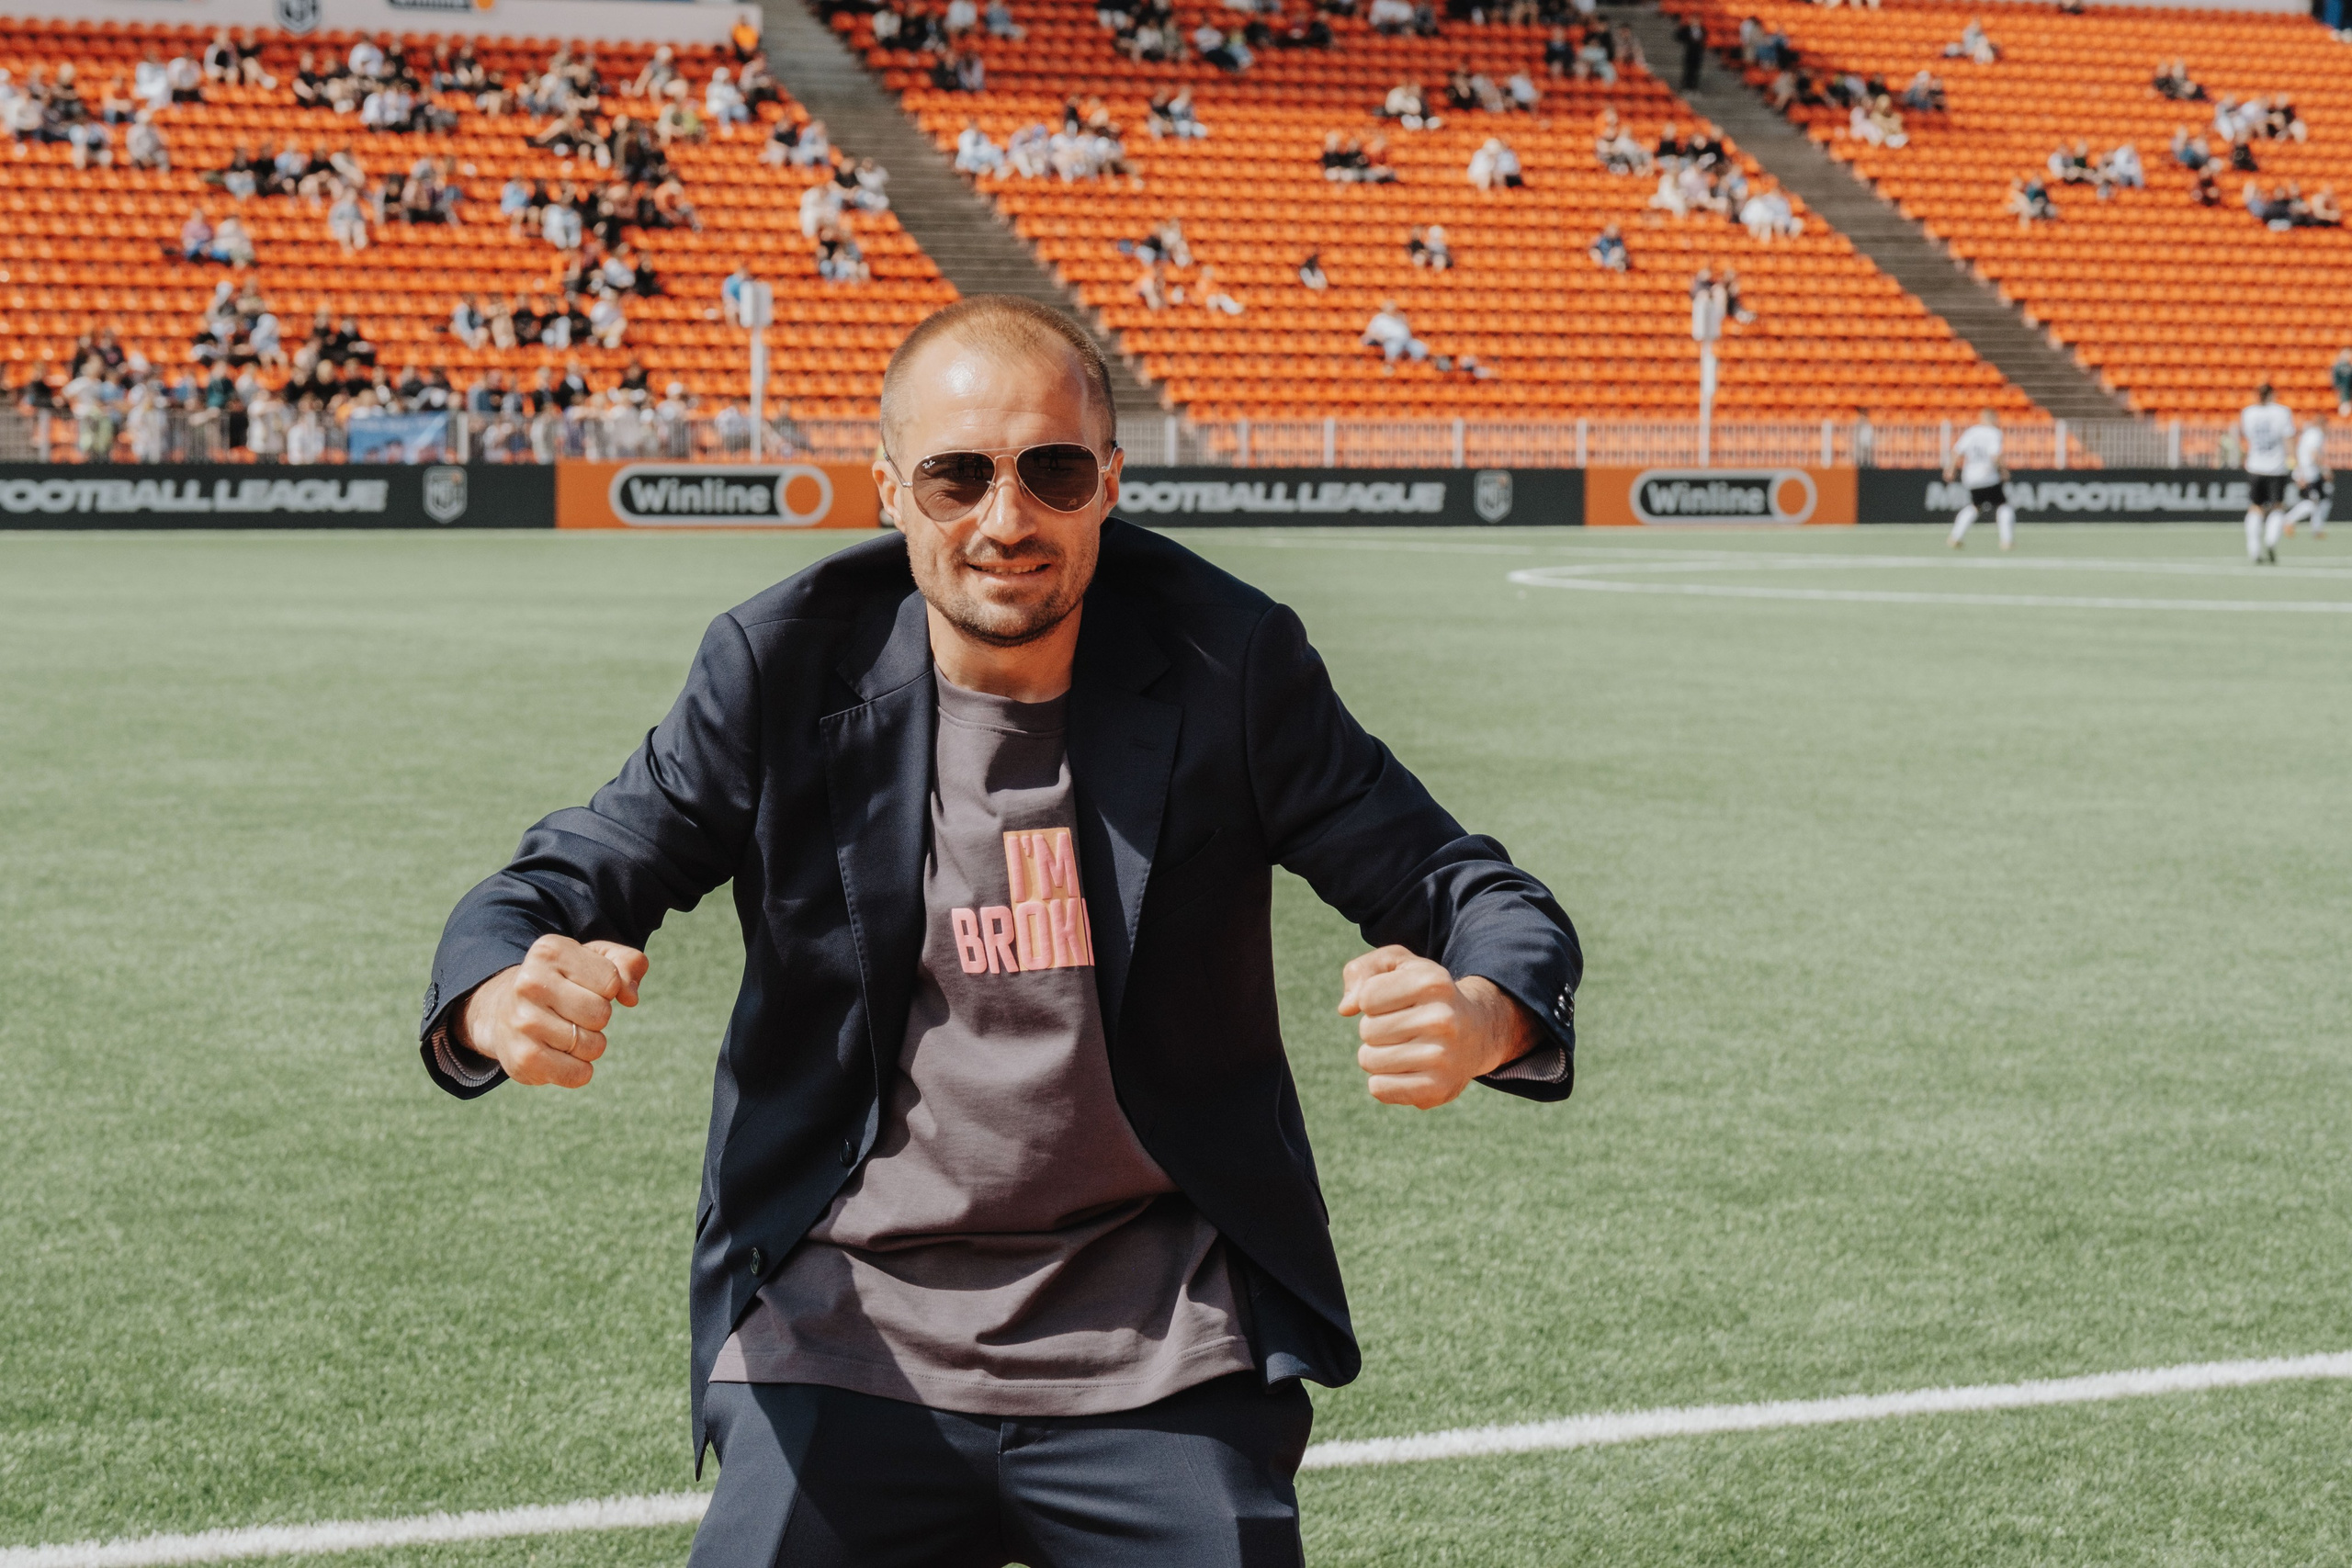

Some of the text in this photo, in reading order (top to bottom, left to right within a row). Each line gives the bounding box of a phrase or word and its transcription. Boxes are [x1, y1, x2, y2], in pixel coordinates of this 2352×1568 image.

[212, 478, 389, 513] LEAGUE
[628, 477, 771, 513] Winline
[1118, 480, 1295, 513] OOTBALL
[1296, 480, 1447, 513] LEAGUE
[1646, 480, 1766, 514] Winline
[2035, 480, 2207, 513] FOOTBALL
[1007, 831, 1079, 903] I'M
